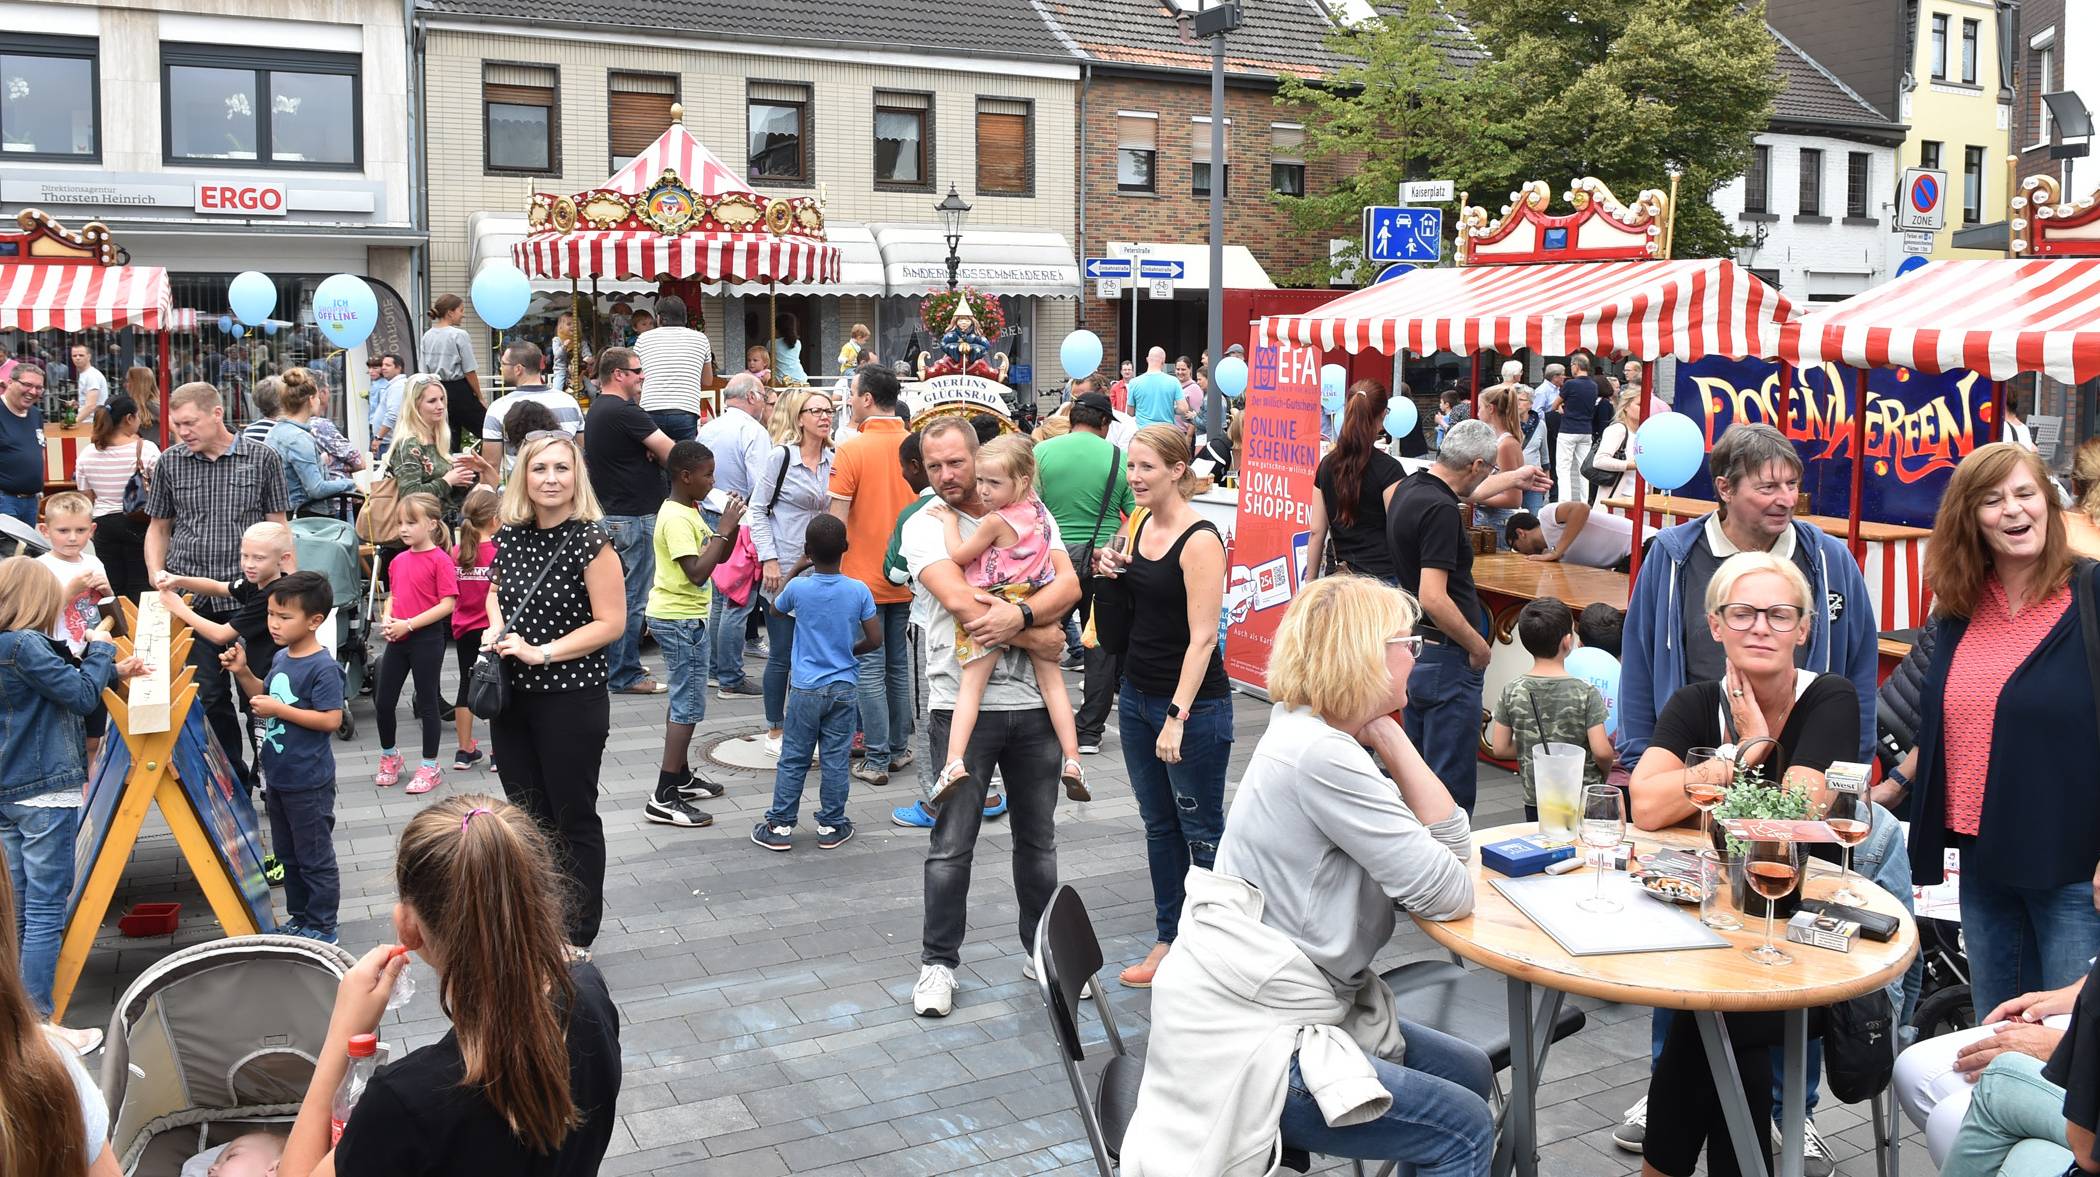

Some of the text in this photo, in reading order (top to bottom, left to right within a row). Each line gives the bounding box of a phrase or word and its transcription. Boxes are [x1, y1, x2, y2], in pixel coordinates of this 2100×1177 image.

[41, 184, 116, 194] Direktionsagentur
[1411, 186, 1446, 199] Kaiserplatz
[41, 191, 156, 205] Thorsten Heinrich
[201, 186, 282, 210] ERGO
[1912, 215, 1933, 226] ZONE
[1124, 246, 1150, 254] Peterstraße
[333, 299, 349, 307] ICH
[318, 312, 358, 321] OFFLINE
[1278, 345, 1318, 385] EFA
[931, 377, 988, 390] MERLINS
[923, 388, 997, 404] GLÜCKSRAD
[1251, 416, 1297, 440] ONLINE
[1248, 438, 1315, 466] SCHENKEN
[1246, 470, 1292, 499] LOKAL
[1244, 493, 1313, 525] SHOPPEN
[456, 568, 489, 576] TOMY
[1234, 627, 1273, 647] Auch als Kart
[1831, 780, 1856, 790] West
